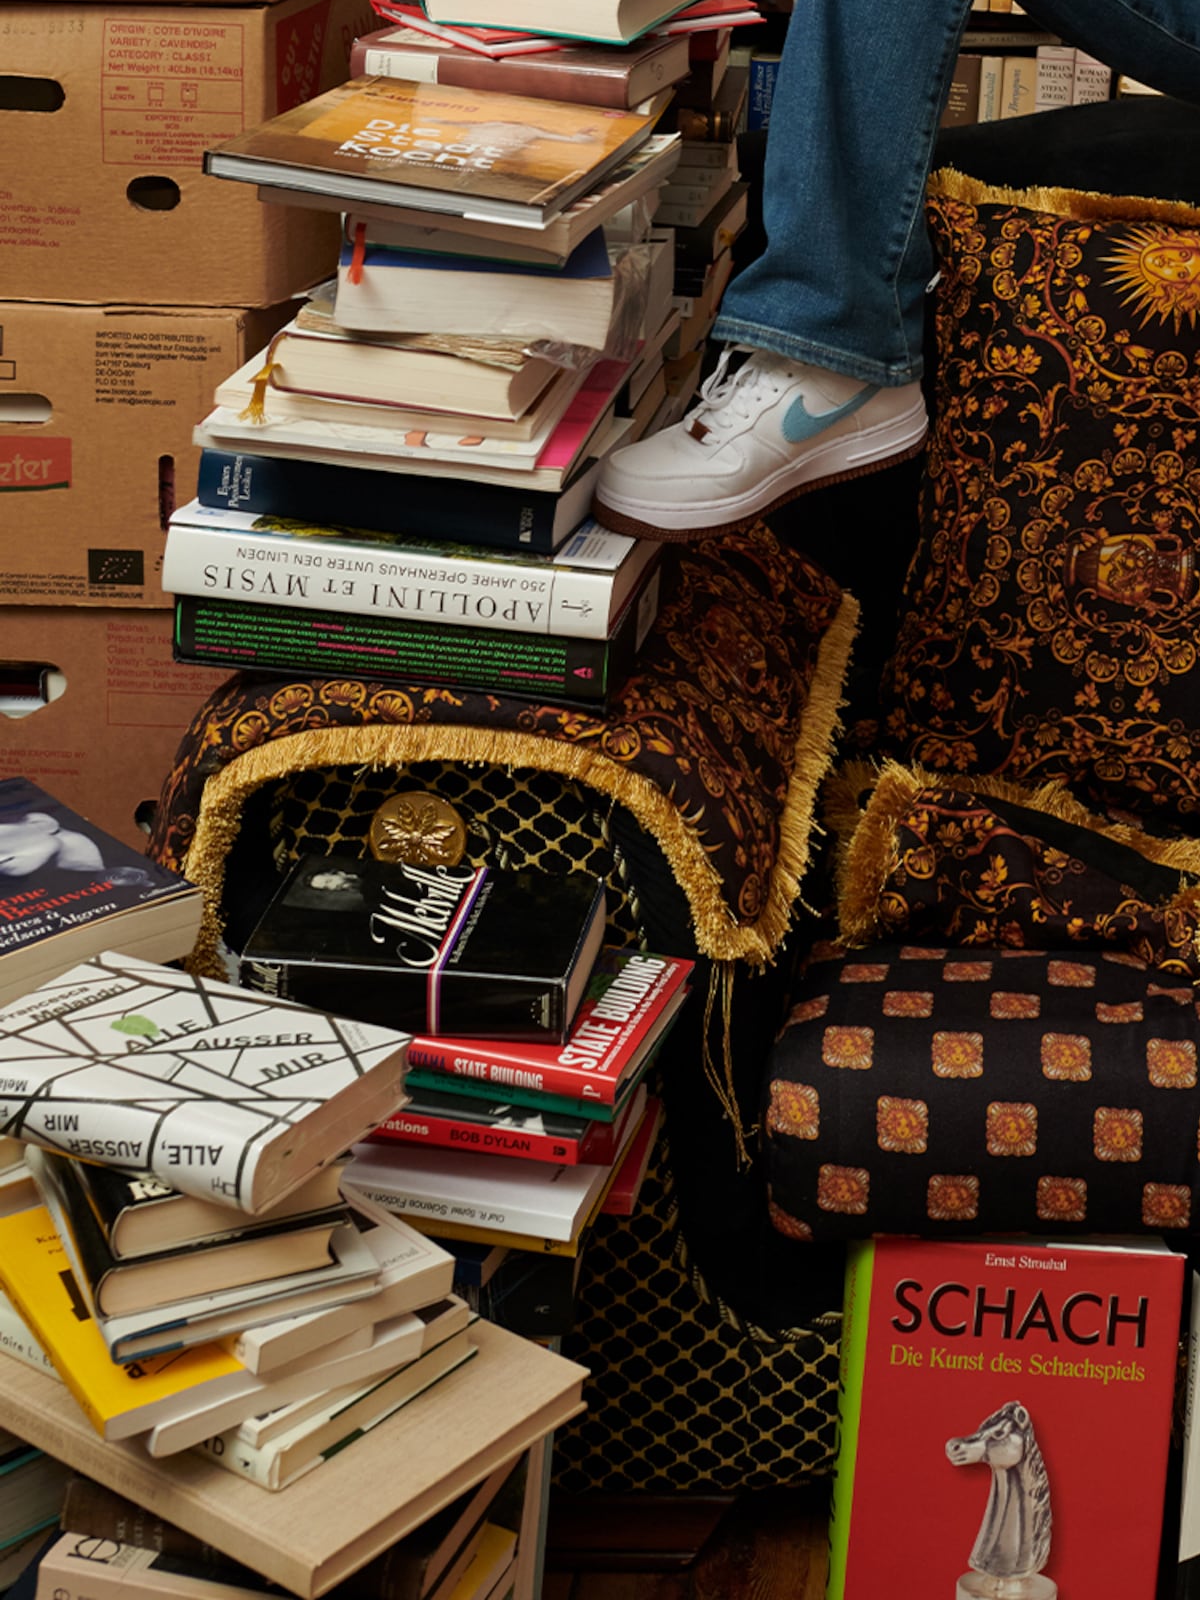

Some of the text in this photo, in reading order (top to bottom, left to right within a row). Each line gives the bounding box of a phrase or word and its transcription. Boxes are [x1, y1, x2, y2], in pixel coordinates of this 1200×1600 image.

[110, 25, 146, 35] ORIGIN
[153, 26, 181, 37] COTE
[110, 38, 217, 50] VARIETY CAVENDISH
[109, 50, 164, 61] CATEGORY
[366, 119, 442, 138] Die
[354, 130, 503, 158] Stadt
[236, 547, 547, 592] 250 JAHRE OPERNHAUS UNTER DEN LINDEN
[203, 563, 544, 623] APOLLINI ET MVSIS
[0, 881, 113, 920] Beauvoir
[59, 900, 118, 928] Algren
[369, 861, 478, 968] Melville
[30, 983, 126, 1024] Melandri
[556, 954, 670, 1071] STATE BUILDING
[193, 1032, 315, 1051] AUSSER
[260, 1051, 330, 1081] MIR
[454, 1058, 545, 1091] STATE BUILDING
[44, 1114, 79, 1132] MIR
[69, 1138, 142, 1159] AUSSER
[161, 1141, 224, 1167] ALLE,
[450, 1128, 531, 1153] BOB DYLAN
[984, 1252, 1067, 1272] Ernst Strouhal
[890, 1278, 1149, 1349] SCHACH
[889, 1344, 1146, 1385] Die Kunst des Schachspiels
